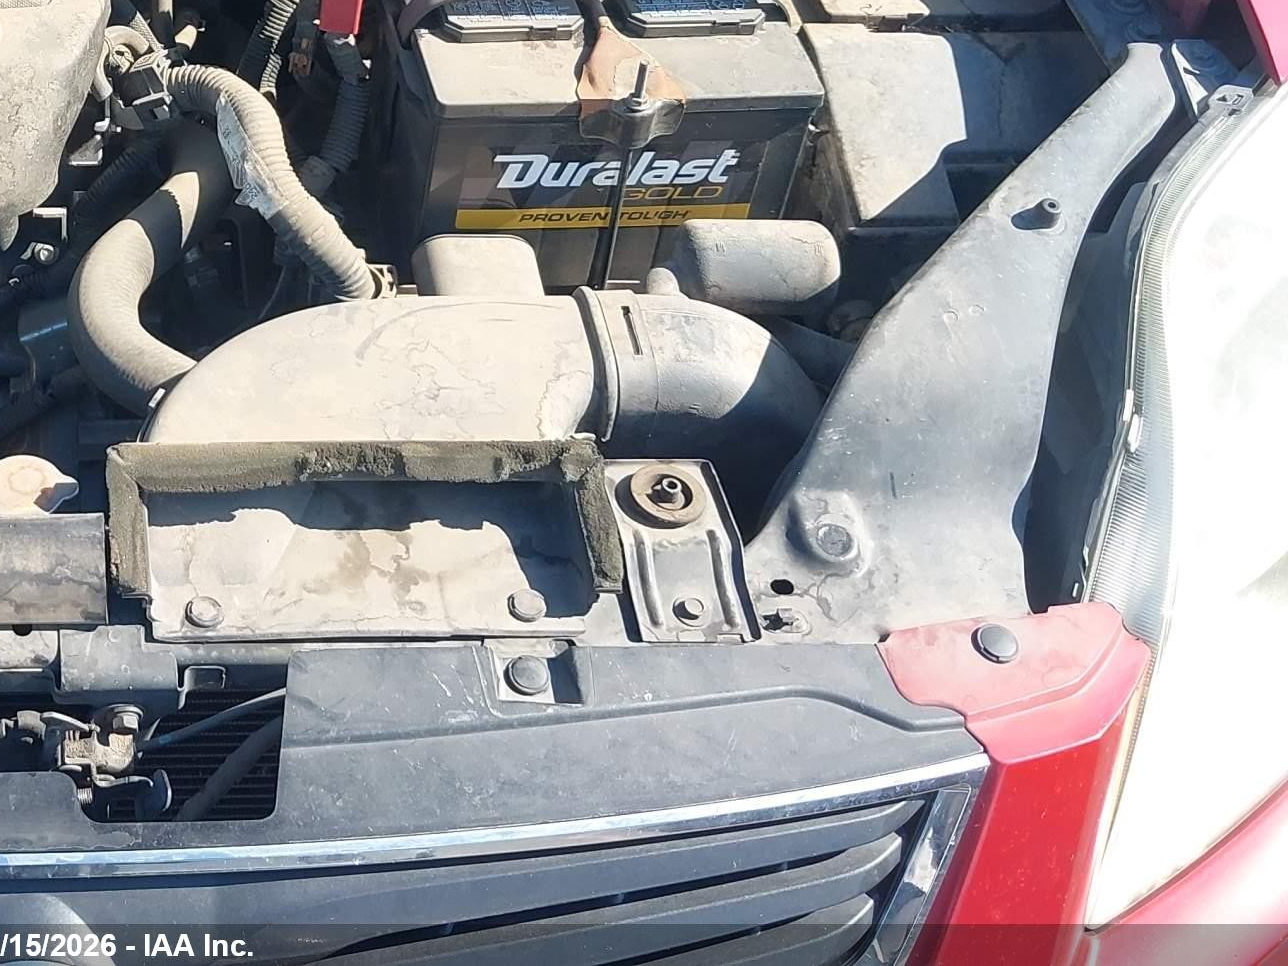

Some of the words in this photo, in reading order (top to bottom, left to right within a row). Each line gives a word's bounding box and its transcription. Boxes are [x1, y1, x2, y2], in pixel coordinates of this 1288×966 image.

[493, 149, 740, 189] Duralast
[623, 186, 723, 201] GOLD
[519, 211, 609, 223] PROVEN
[619, 210, 689, 220] TOUGH
